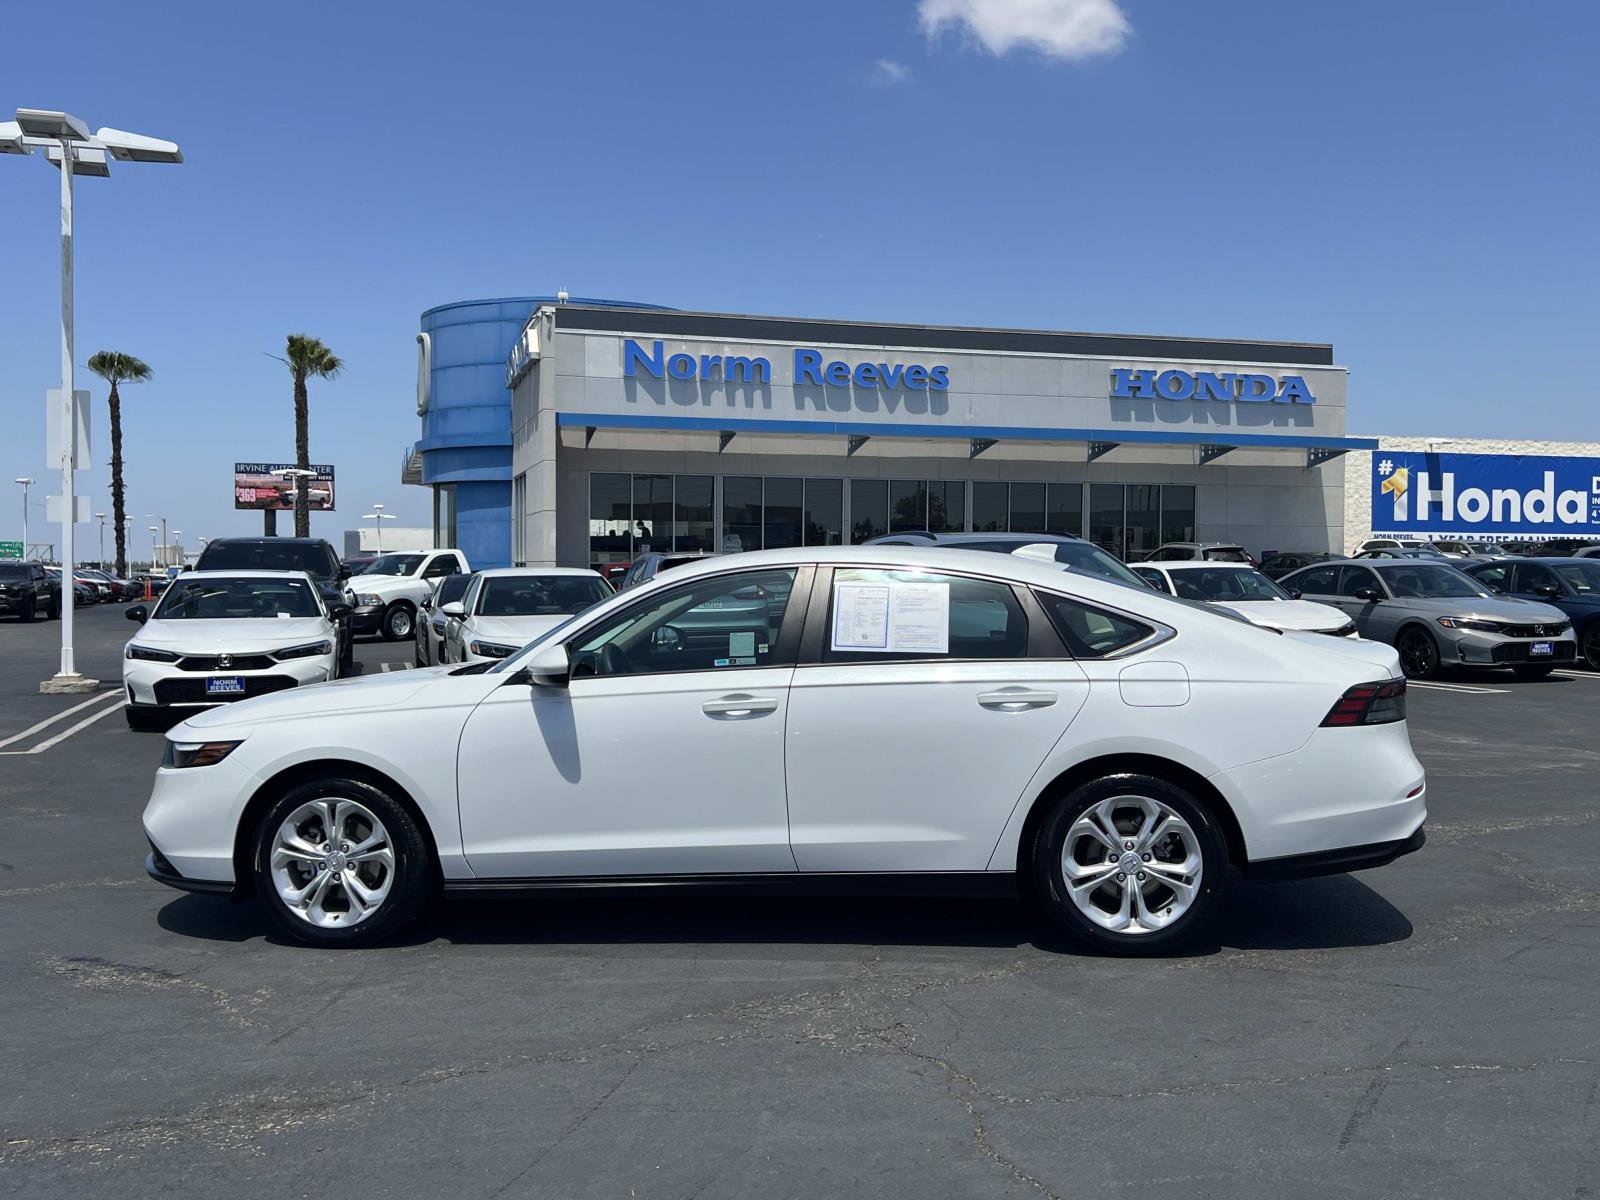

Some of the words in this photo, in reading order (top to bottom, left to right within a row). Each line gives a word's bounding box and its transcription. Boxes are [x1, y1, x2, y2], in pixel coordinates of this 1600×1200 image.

[623, 338, 771, 384] Norm
[793, 346, 950, 392] Reeves
[1110, 367, 1317, 405] HONDA
[237, 464, 267, 472] IRVINE
[1416, 470, 1588, 524] Honda
